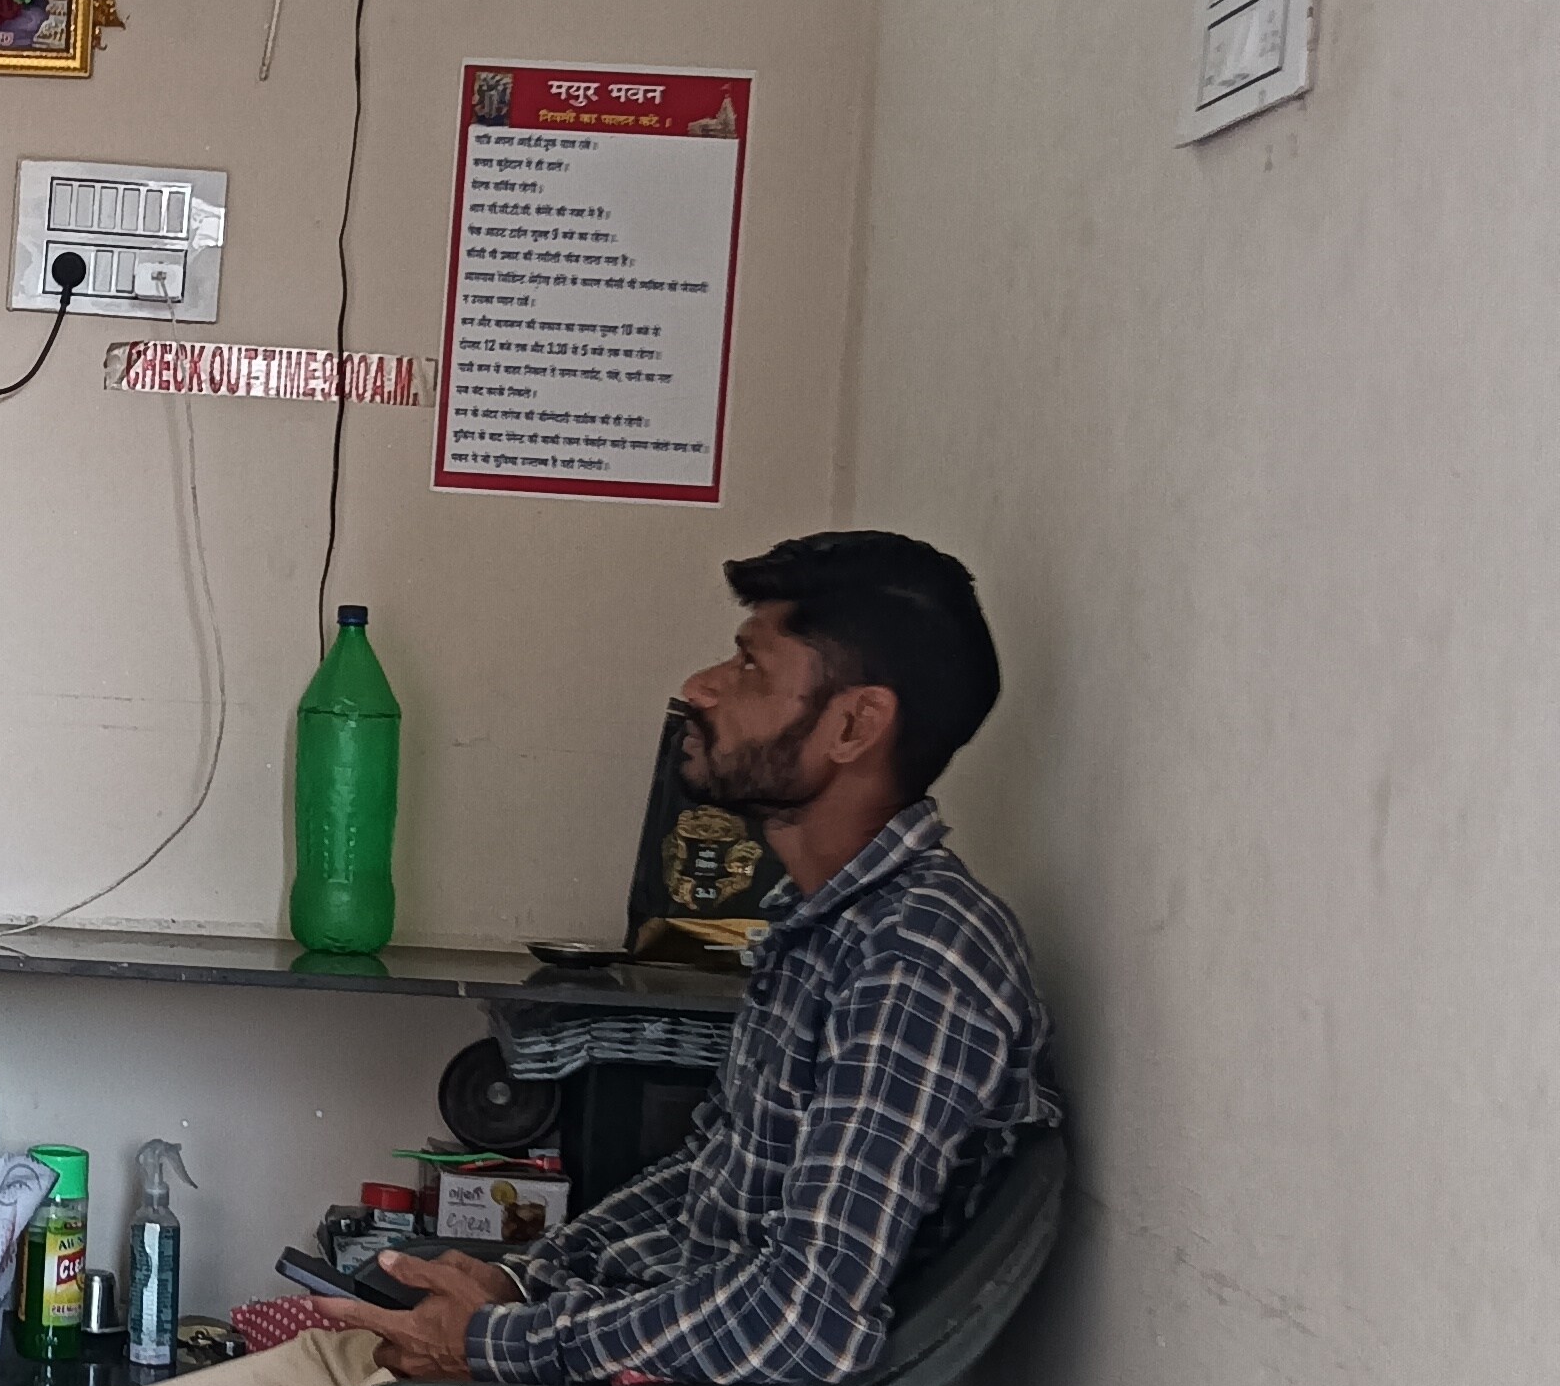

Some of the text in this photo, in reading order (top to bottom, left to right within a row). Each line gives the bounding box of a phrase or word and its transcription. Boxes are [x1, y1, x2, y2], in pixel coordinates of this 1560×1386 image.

[608, 84, 665, 105] भवन
[579, 113, 598, 124] का
[601, 113, 635, 126] पालन
[551, 227, 559, 240] 9
[620, 323, 634, 336] 10
[483, 338, 496, 352] 12
[580, 343, 589, 357] 5
[126, 340, 206, 392] CHECK
[209, 345, 258, 395] OUT
[263, 348, 317, 400] TIME
[59, 1239, 74, 1251] All
